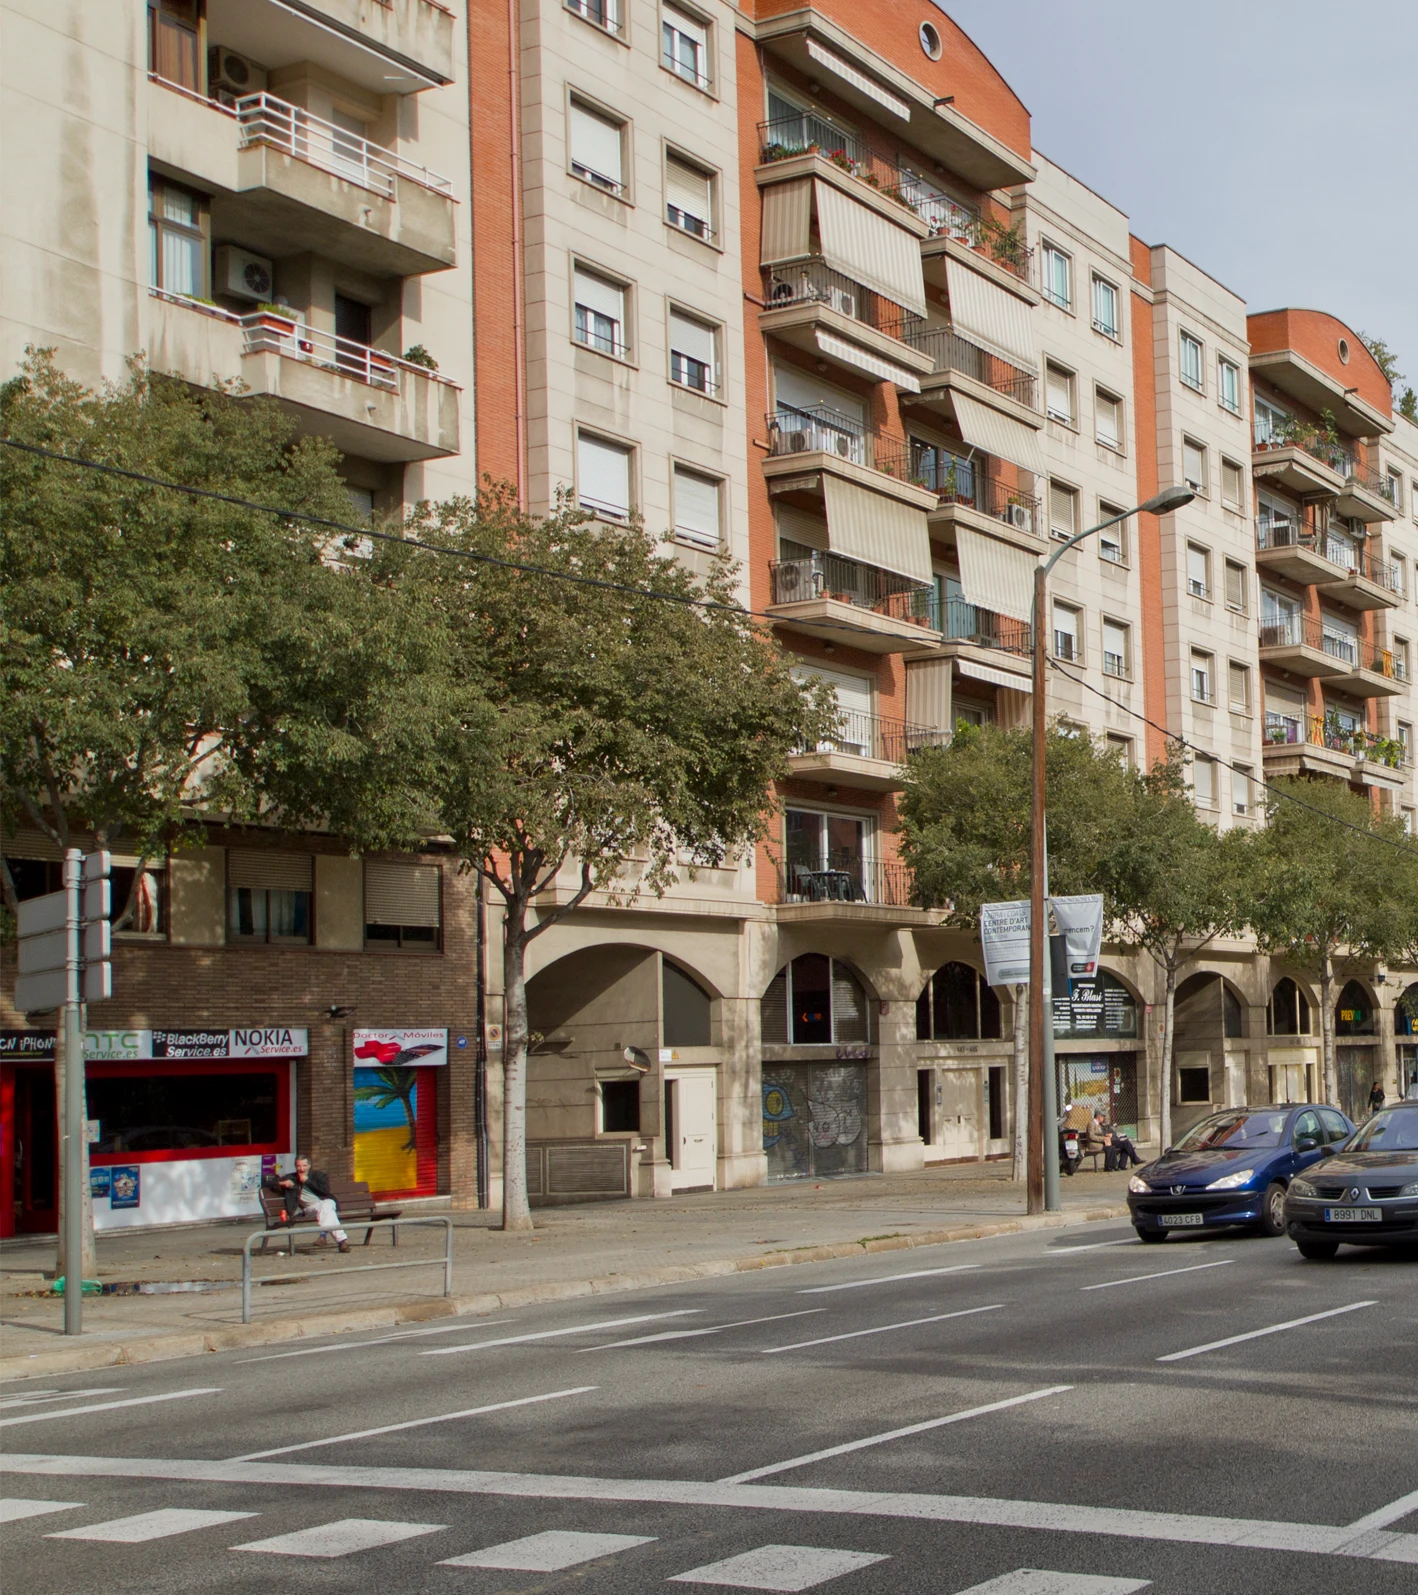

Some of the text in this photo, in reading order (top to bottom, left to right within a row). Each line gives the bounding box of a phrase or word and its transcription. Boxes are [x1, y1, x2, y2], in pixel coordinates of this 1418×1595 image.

[984, 916, 1028, 927] CENTRE D'ART
[167, 1033, 229, 1046] BlackBerry
[235, 1030, 293, 1046] NOKIA
[403, 1031, 444, 1039] Móviles
[83, 1049, 138, 1059] Service.es
[166, 1046, 227, 1057] Service.es
[260, 1045, 302, 1054] Service.es
[1163, 1215, 1201, 1225] 4023 CFB
[1334, 1209, 1378, 1220] 8991 DNL
